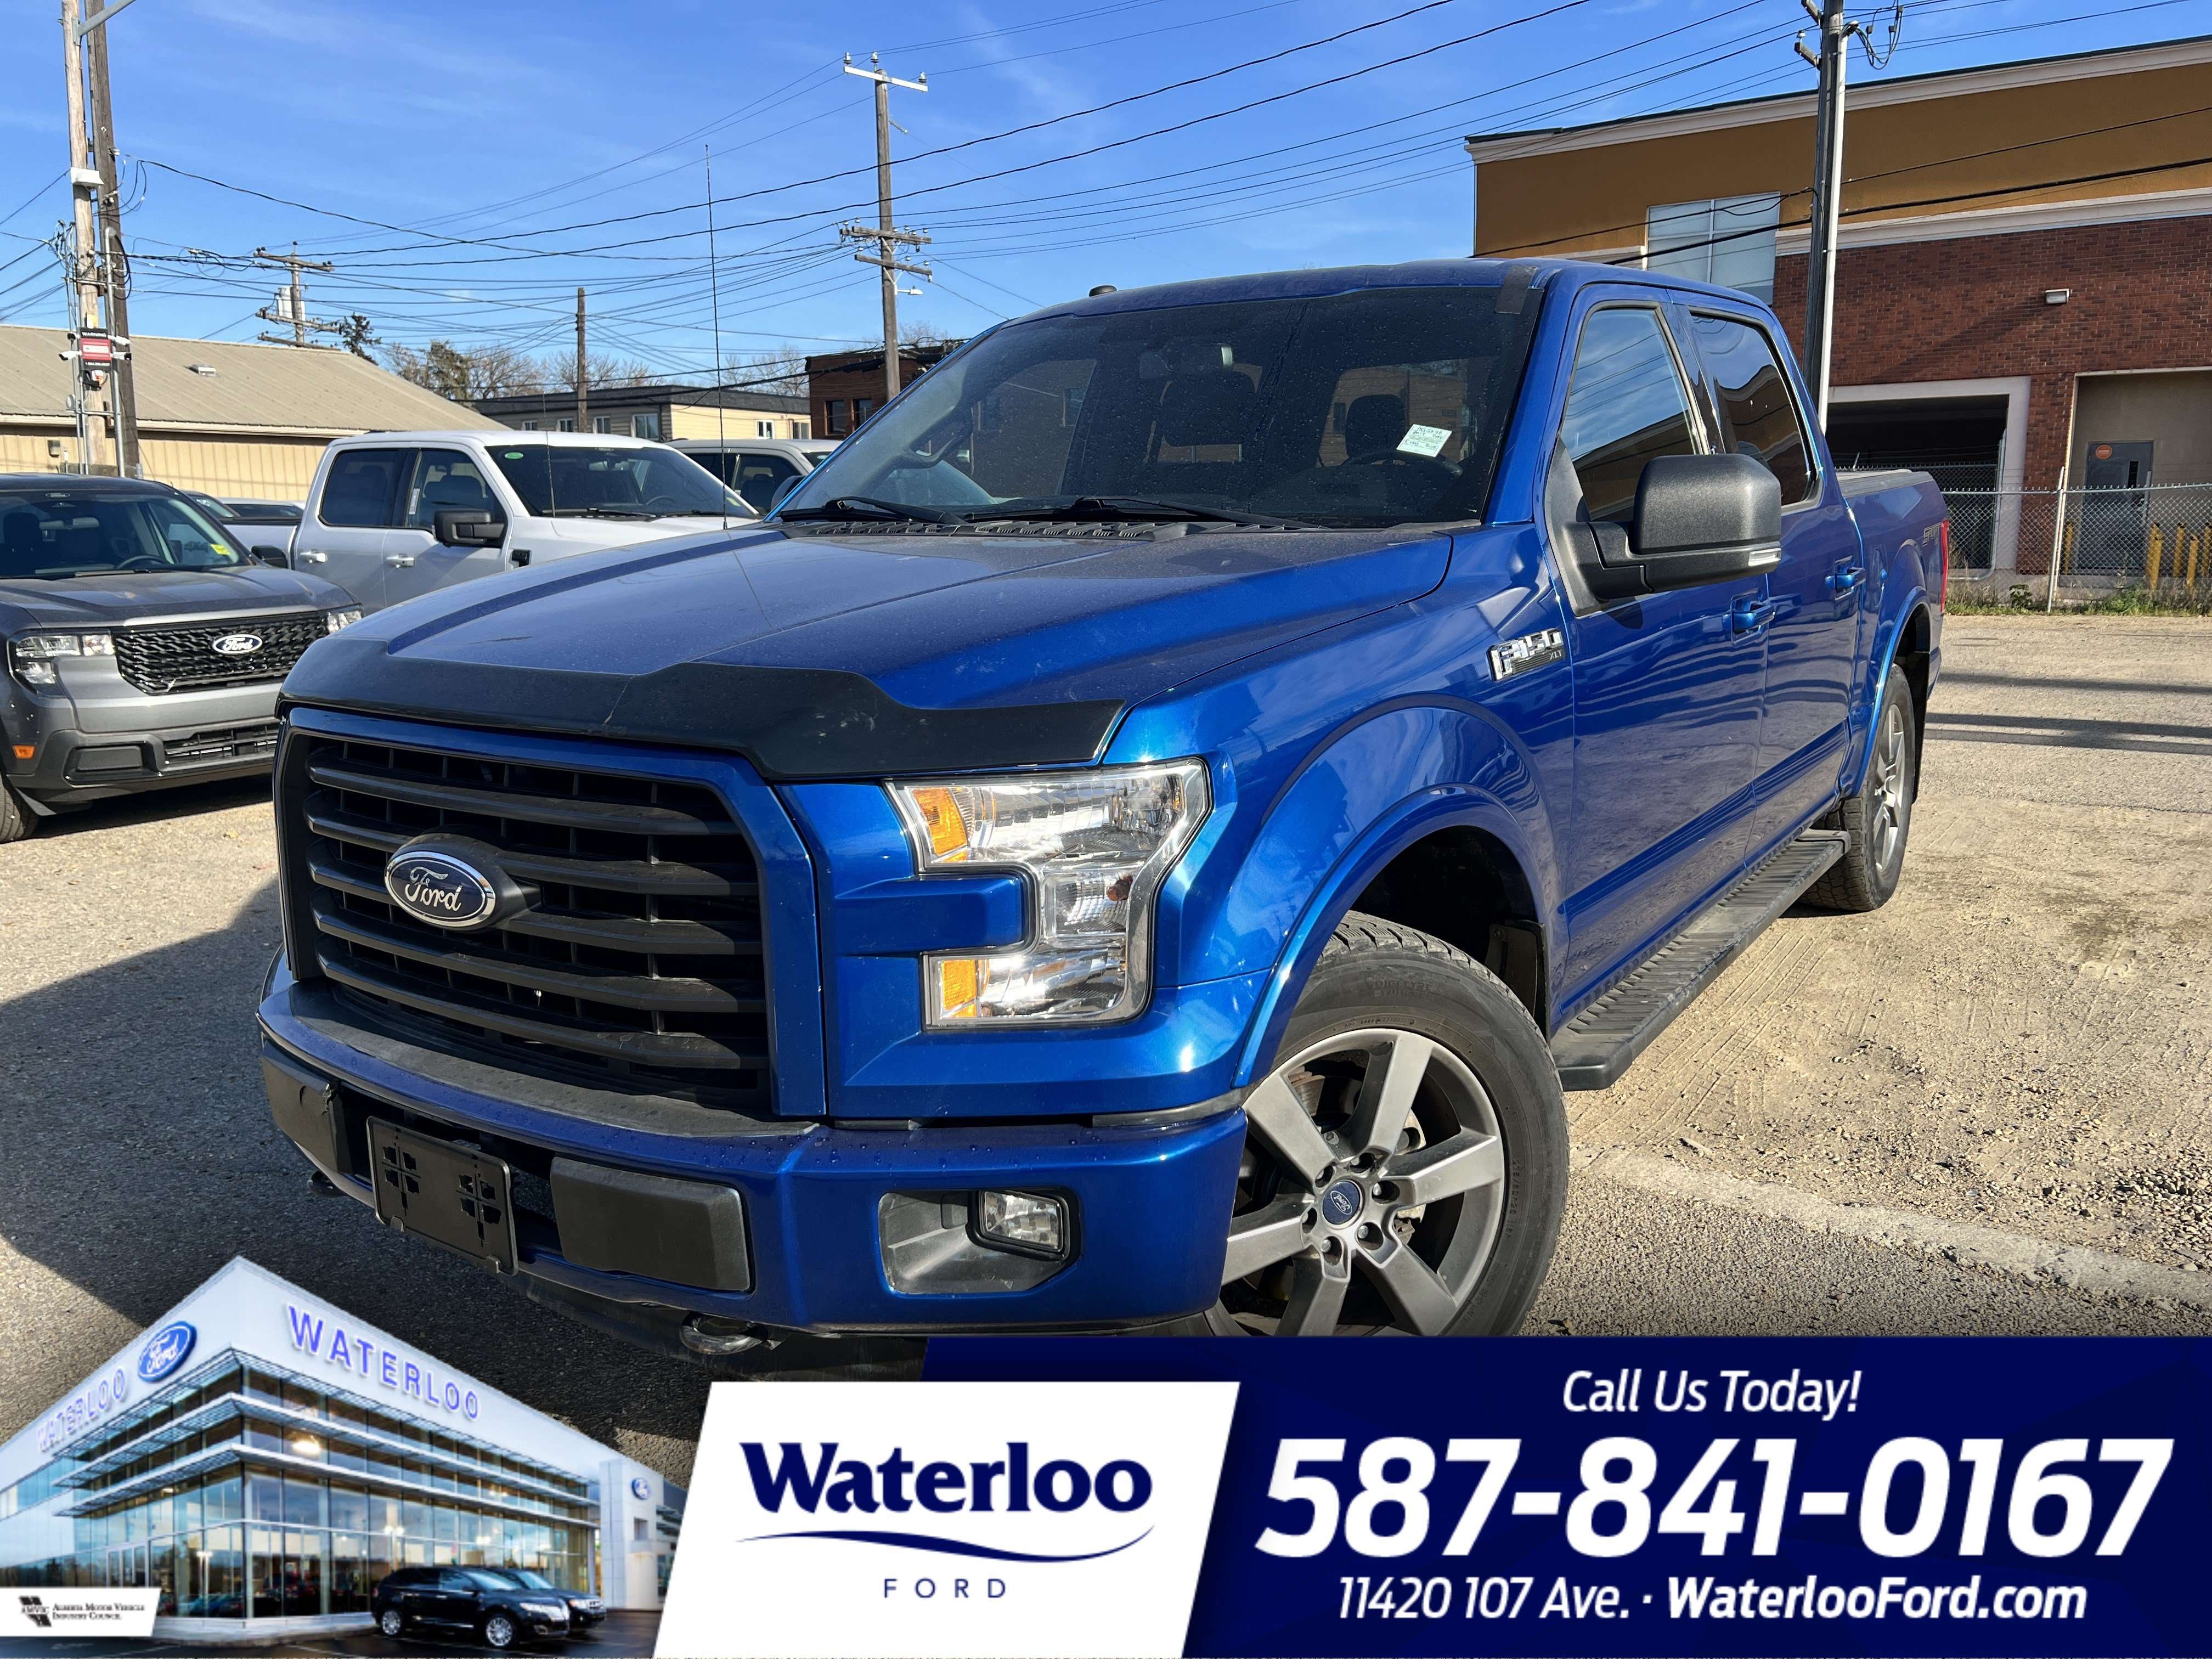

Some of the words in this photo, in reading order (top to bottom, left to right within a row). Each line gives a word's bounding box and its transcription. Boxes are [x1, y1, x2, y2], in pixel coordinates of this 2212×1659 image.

[222, 637, 253, 652] Ford
[1549, 652, 1562, 661] XLT
[404, 866, 463, 912] Ford
[1334, 1193, 1351, 1212] Ford
